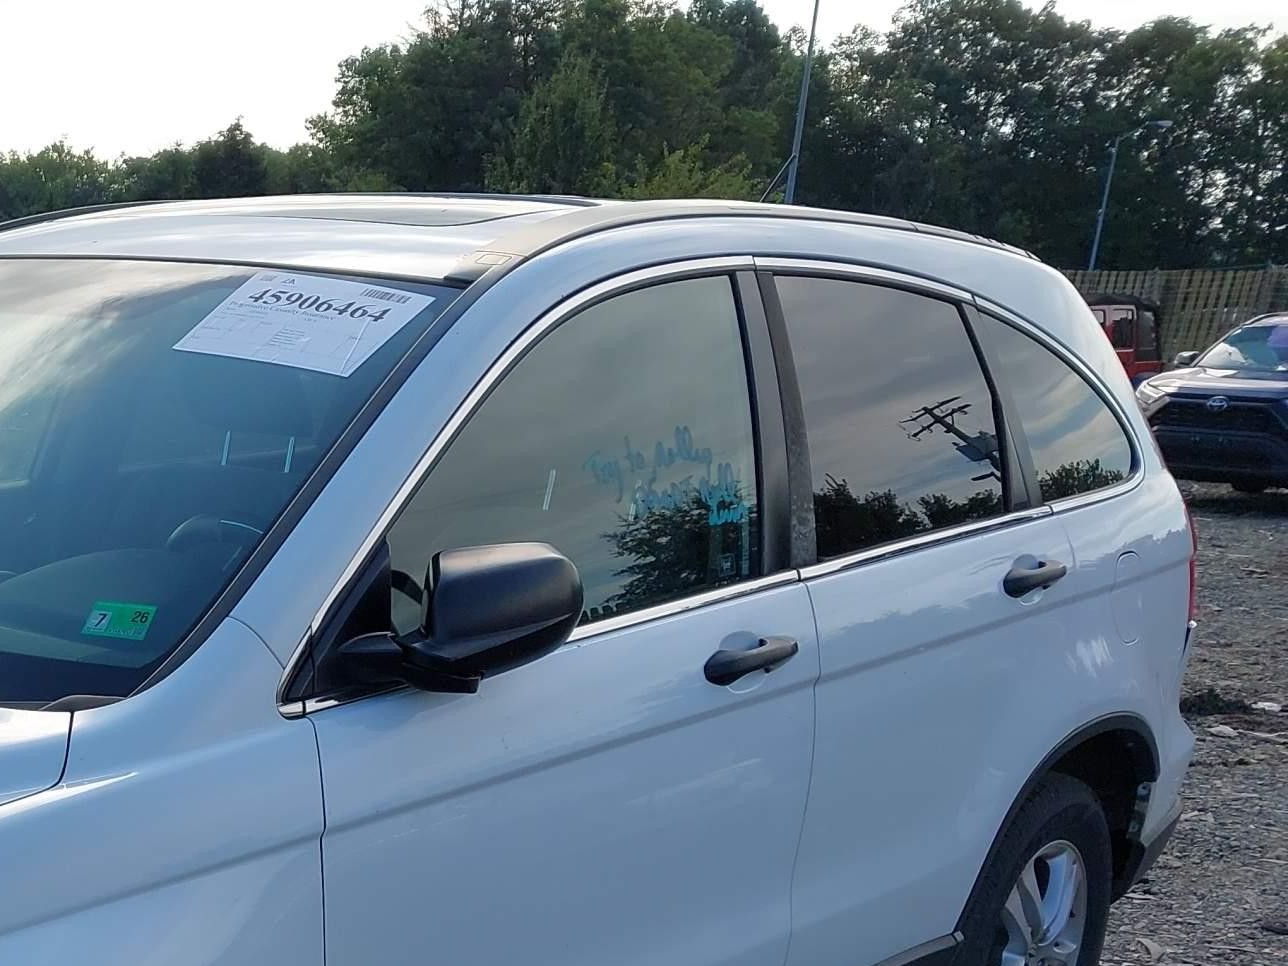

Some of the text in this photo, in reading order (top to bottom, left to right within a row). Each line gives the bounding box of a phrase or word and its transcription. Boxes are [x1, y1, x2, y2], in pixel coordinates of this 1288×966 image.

[248, 288, 392, 323] 45906464
[94, 611, 150, 627] 7 26
